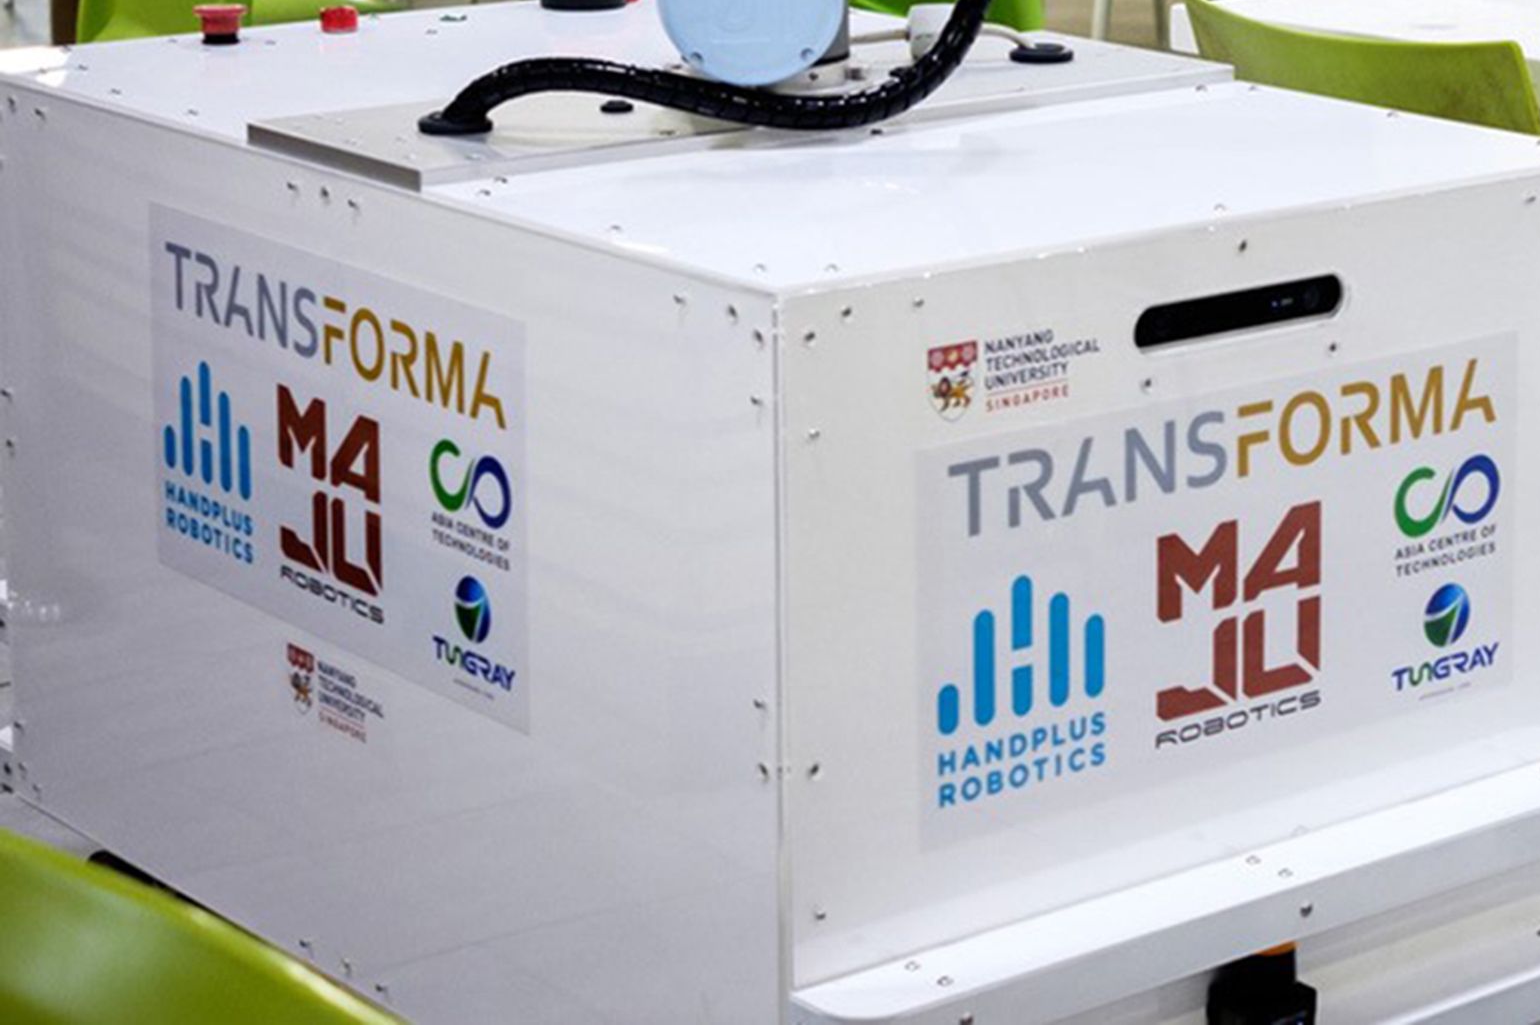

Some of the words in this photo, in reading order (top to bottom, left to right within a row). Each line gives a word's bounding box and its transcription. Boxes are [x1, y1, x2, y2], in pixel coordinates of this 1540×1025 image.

[165, 241, 507, 430] TRANSFORMA
[985, 330, 1053, 353] NANYANG
[986, 340, 1100, 371] TECHNOLOGICAL
[984, 361, 1069, 390] UNIVERSITY
[985, 384, 1069, 413] SINGAPORE
[948, 358, 1497, 537] TRANSFORMA
[165, 480, 253, 536] HANDPLUS
[165, 507, 254, 564] ROBOTICS
[431, 529, 511, 571] TECHNOLOGIES
[456, 521, 494, 548] CENTRE
[497, 537, 510, 552] OF
[1395, 543, 1425, 561] ASIA
[1428, 529, 1477, 552] CENTRE
[1480, 523, 1496, 538] OF
[1396, 542, 1497, 576] TECHNOLOGIES
[279, 564, 385, 625] ROBOTICS
[938, 712, 1106, 776] HANDPLUS
[1154, 690, 1321, 750] ROBOTICS
[938, 742, 1106, 808] ROBOTICS
